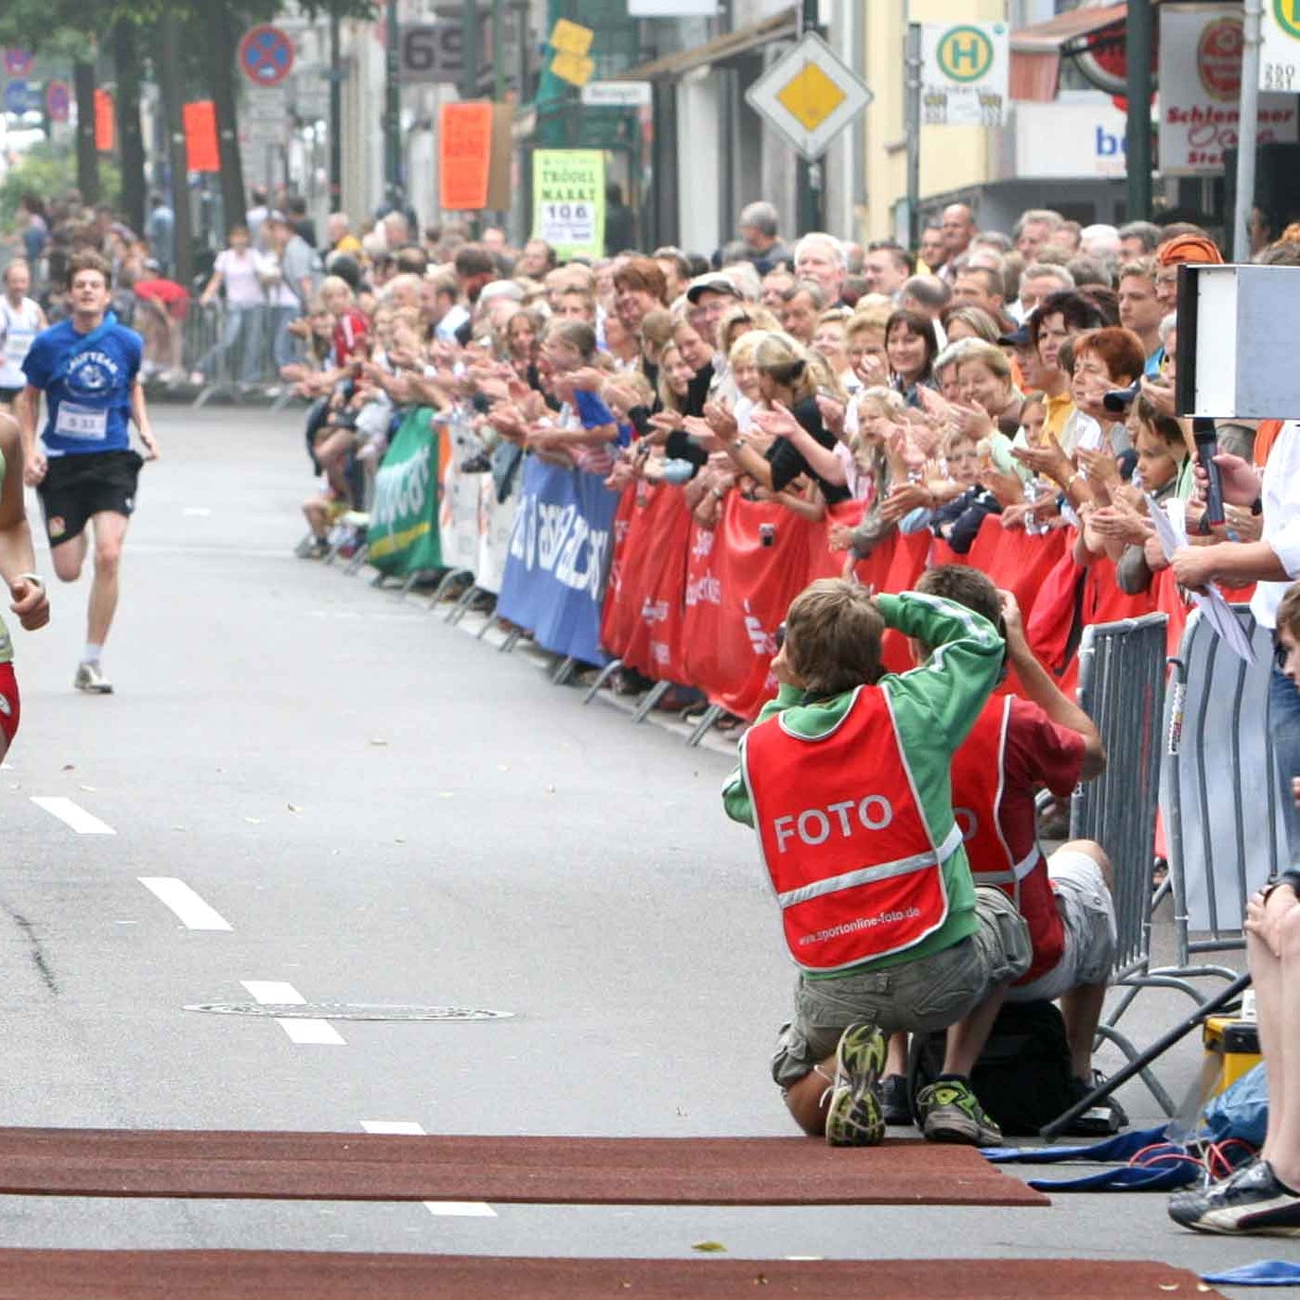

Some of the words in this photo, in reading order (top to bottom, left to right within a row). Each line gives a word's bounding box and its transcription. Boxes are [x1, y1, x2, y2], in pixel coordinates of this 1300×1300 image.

[952, 39, 979, 69] H
[548, 204, 588, 219] 106
[773, 795, 893, 853] FOTO
